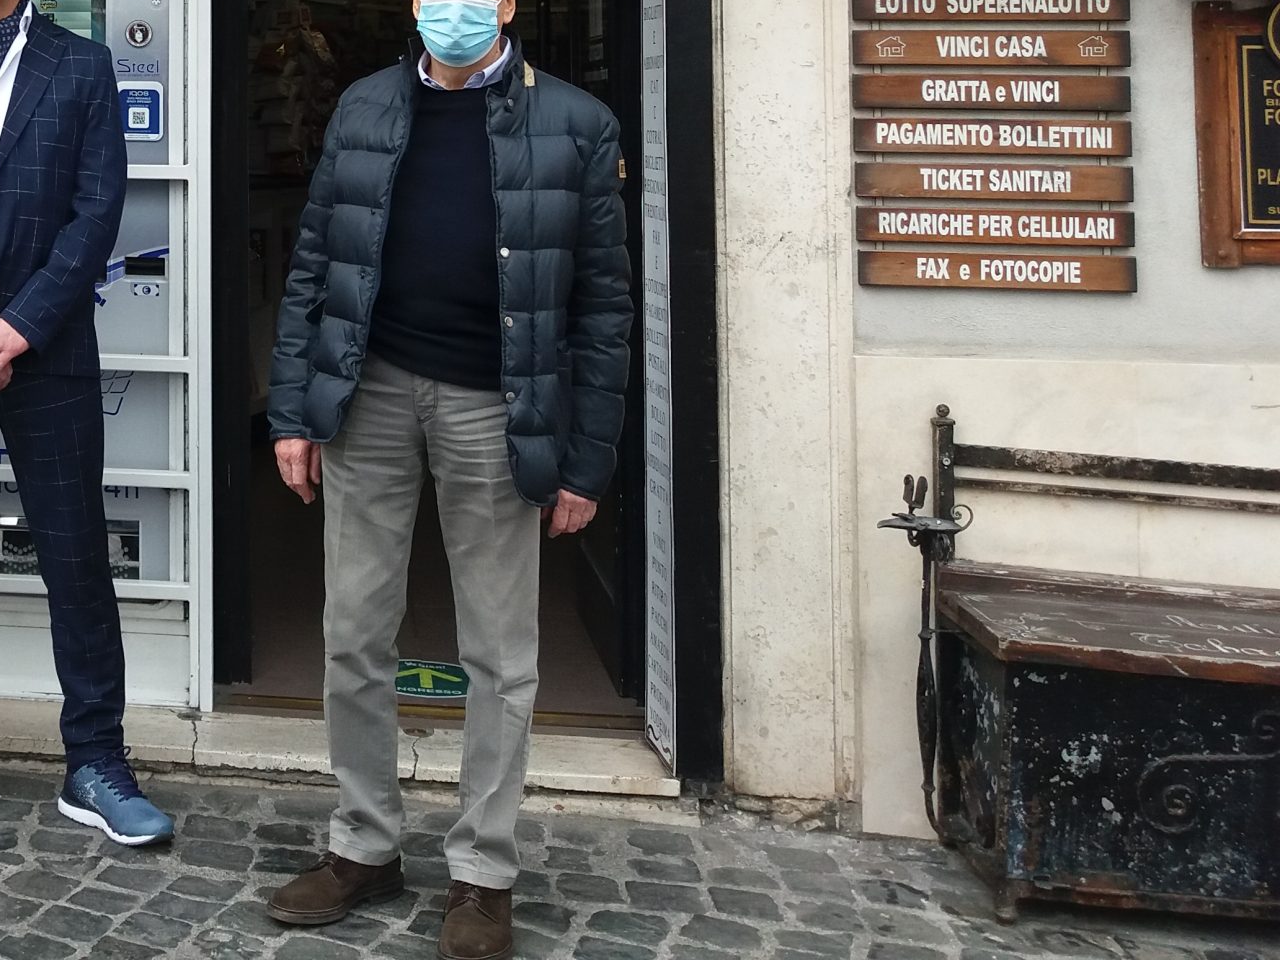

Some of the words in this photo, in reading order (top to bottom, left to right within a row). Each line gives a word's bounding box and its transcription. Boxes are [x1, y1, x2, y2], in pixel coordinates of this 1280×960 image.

[935, 35, 989, 58] VINCI
[994, 35, 1048, 58] CASA
[116, 58, 159, 73] Steel
[921, 79, 991, 102] GRATTA
[995, 85, 1007, 102] e
[1010, 80, 1060, 103] VINCI
[876, 122, 993, 147] PAGAMENTO
[999, 124, 1113, 149] BOLLETTINI
[920, 168, 984, 191] TICKET
[988, 169, 1071, 193] SANITARI
[878, 212, 974, 236] RICARICHE
[978, 215, 1013, 238] PER
[1017, 215, 1115, 240] CELLULARI
[916, 257, 950, 280] FAX
[959, 263, 970, 280] e
[980, 259, 1081, 284] FOTOCOPIE
